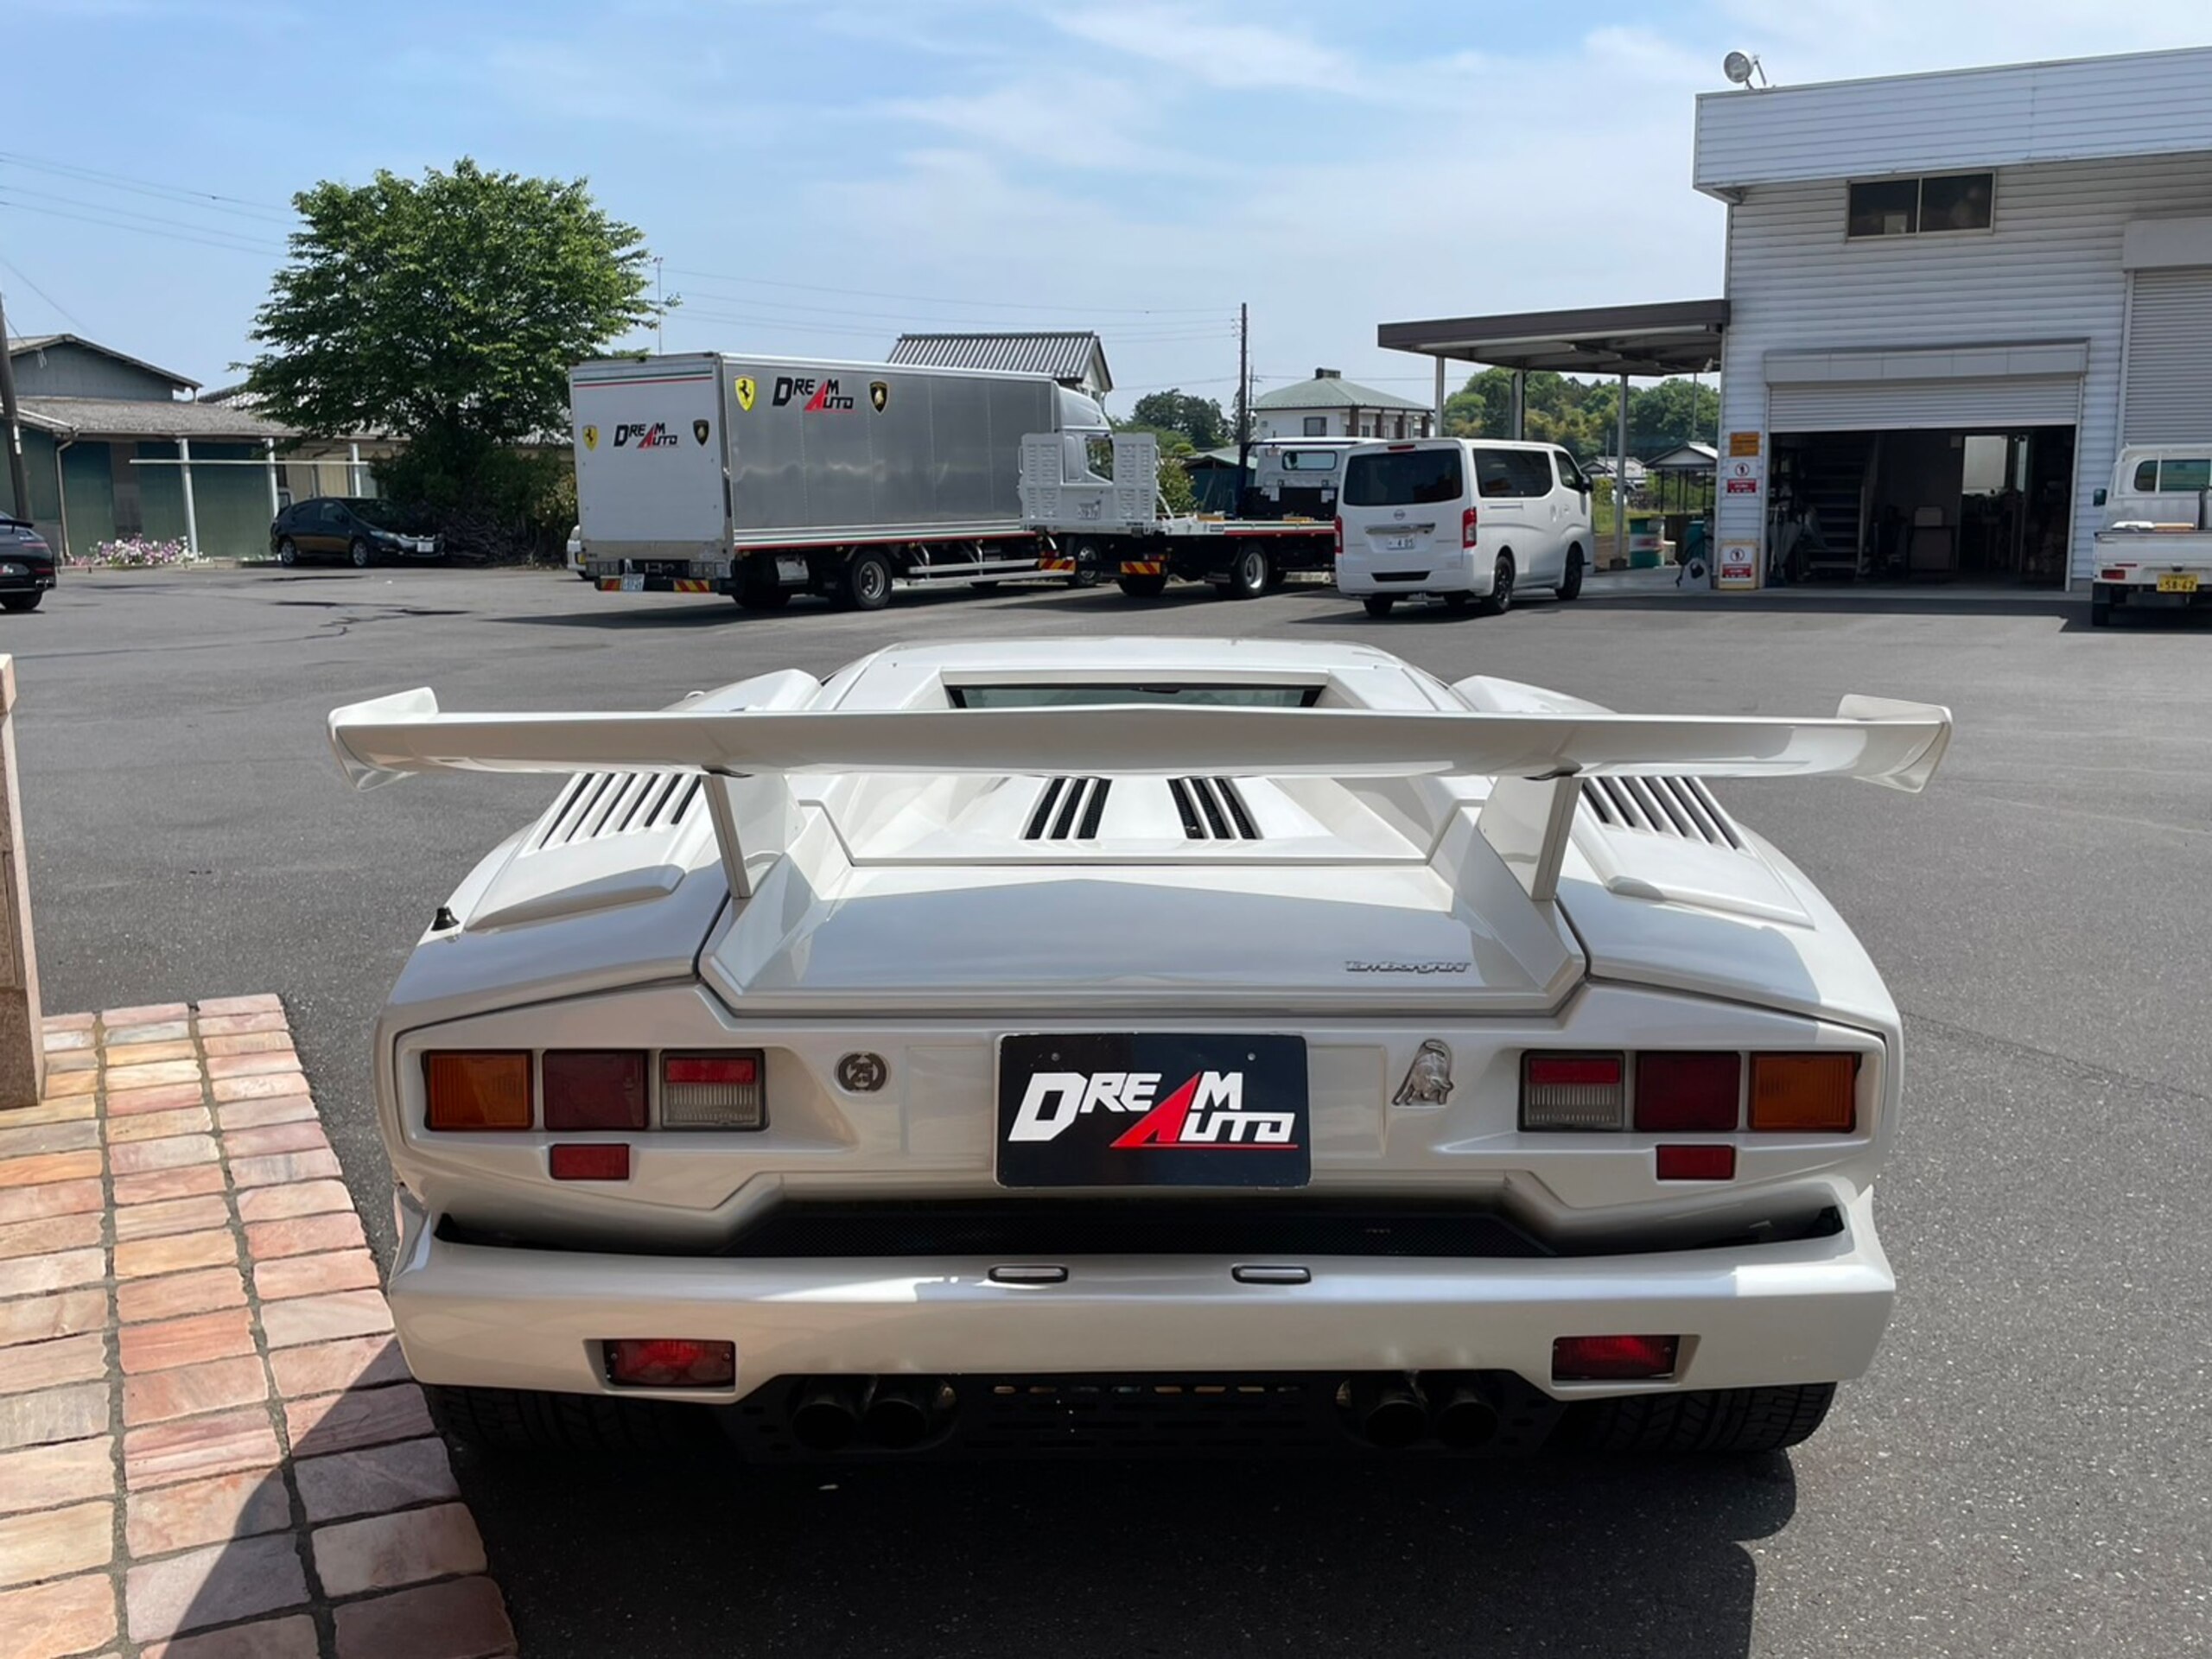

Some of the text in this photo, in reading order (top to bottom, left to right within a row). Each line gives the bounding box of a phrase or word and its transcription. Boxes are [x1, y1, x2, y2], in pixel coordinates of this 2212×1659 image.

[772, 377, 839, 406] DREAM
[804, 380, 854, 412] AUTO
[613, 423, 665, 447] DREAM
[637, 423, 678, 448] AUTO
[1007, 1071, 1243, 1142] DREAM
[1110, 1071, 1295, 1148] AUTO
